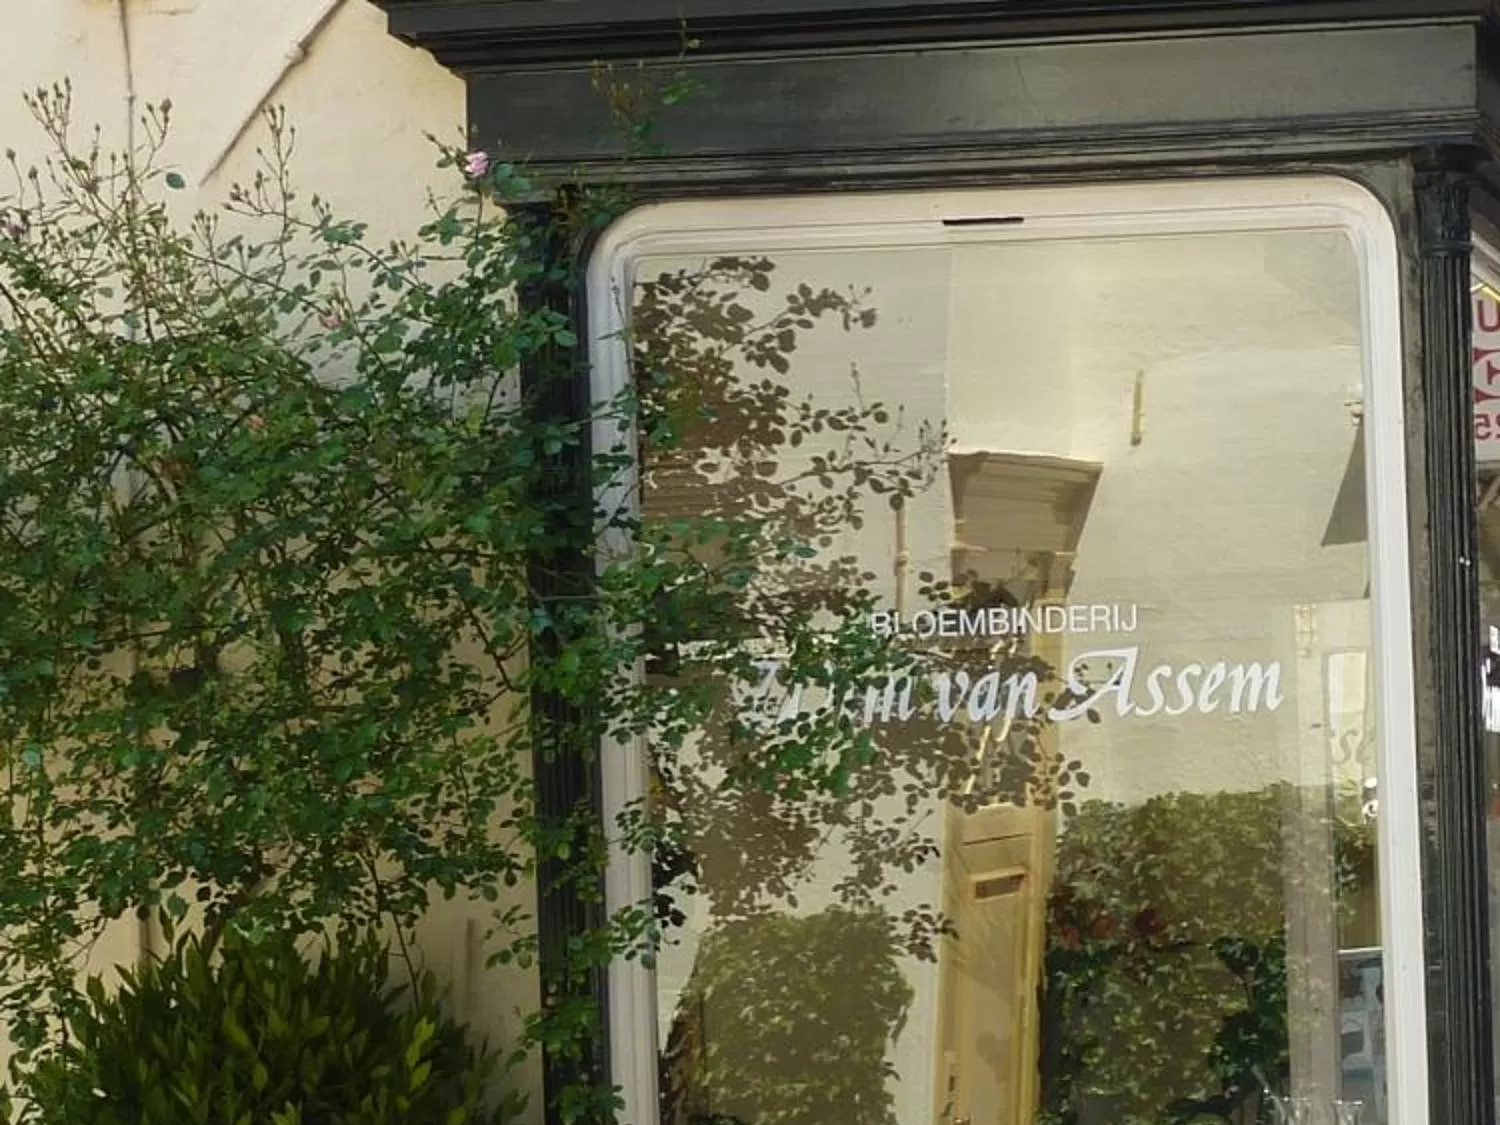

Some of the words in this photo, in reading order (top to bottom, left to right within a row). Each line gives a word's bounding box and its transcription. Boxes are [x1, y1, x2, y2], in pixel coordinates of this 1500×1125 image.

[872, 603, 1138, 638] BLOEMBINDERIJ
[933, 668, 1042, 722] van
[1048, 646, 1284, 721] Assem
